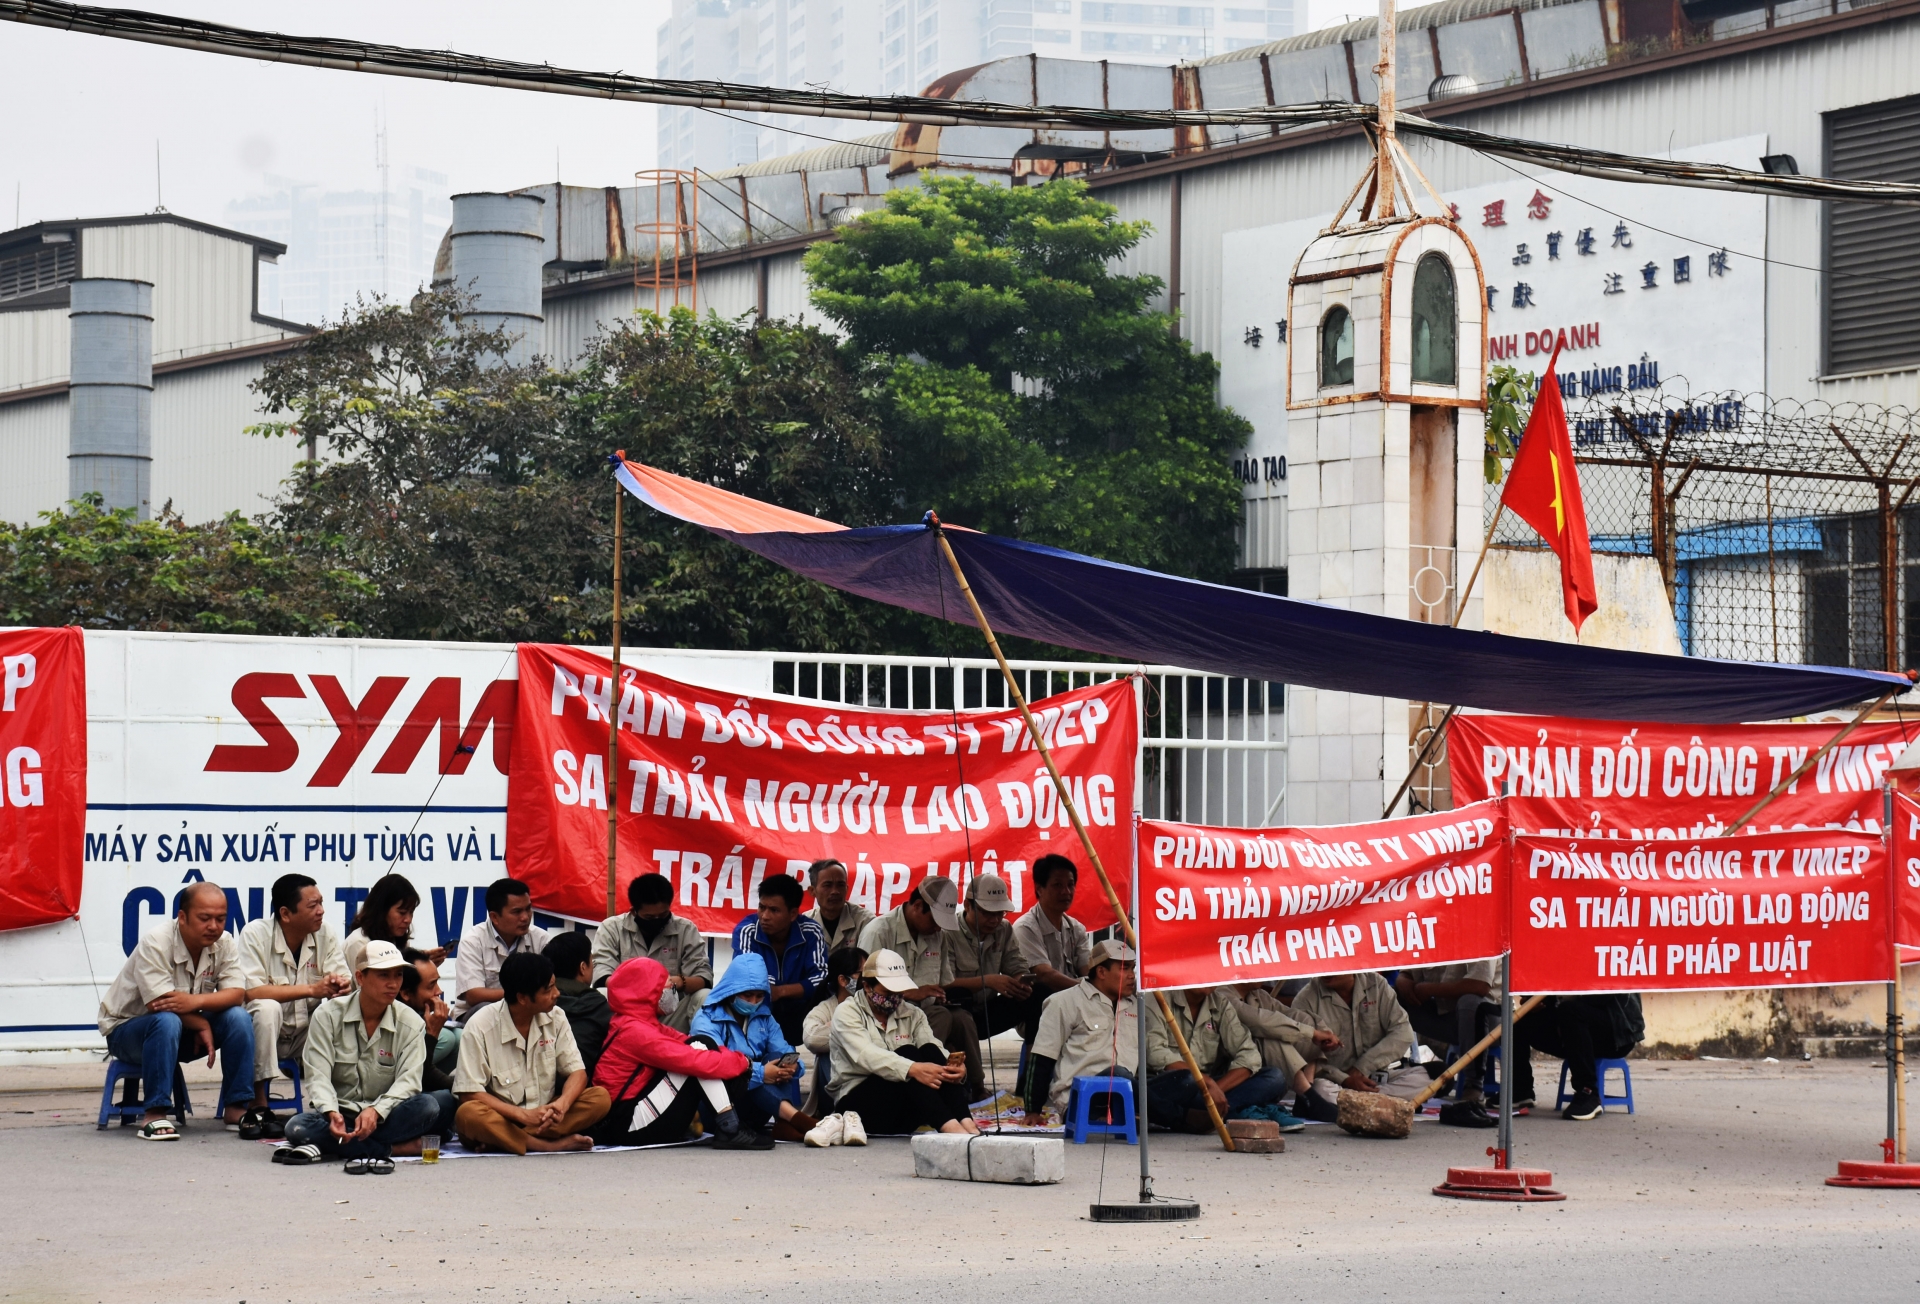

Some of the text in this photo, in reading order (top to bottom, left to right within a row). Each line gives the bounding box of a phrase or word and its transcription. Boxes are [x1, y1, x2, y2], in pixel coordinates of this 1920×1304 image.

[1511, 220, 1633, 266] 品質優先
[1603, 247, 1732, 296] 注重團隊
[1488, 334, 1519, 362] NH
[1581, 362, 1622, 397] HÀNG
[1234, 453, 1287, 487] ĐÀO TẠO
[204, 671, 517, 787] SYM
[552, 662, 686, 739] PHẢN
[786, 714, 925, 755] CÔNG
[922, 723, 981, 754] TY
[989, 698, 1109, 752] VMEP
[0, 747, 43, 807] G
[1483, 729, 1580, 798] PHẢN
[1591, 729, 1650, 797] ĐỐI
[1663, 736, 1757, 797] CÔNG
[1768, 746, 1808, 794] TY
[553, 750, 1115, 840] SA THẢI NGƯỜI LAO ĐỘNG
[86, 825, 147, 861] MÁY
[157, 821, 212, 862] SẢN
[221, 822, 295, 862] XUẤT
[305, 834, 355, 868] PHỤ
[364, 826, 433, 861] TÙNG
[447, 826, 481, 861] VÀ
[1154, 829, 1235, 868] PHẢN
[1294, 838, 1363, 868] CÔNG
[1367, 836, 1402, 863] TY
[1409, 817, 1493, 856] VMEP
[1530, 843, 1870, 880] PHẢN ĐỐI CÔNG TY VMEP
[650, 842, 768, 912] TRÁI
[785, 852, 911, 916] PÁP
[1156, 863, 1491, 920] SA THẢI NGƯỜI LAO ĐỘNG
[1530, 886, 1869, 928] SA THẢI NGƯỜI LAO ĐỘNG
[1218, 912, 1437, 967] TRÁI PHÁP LUẬT
[1595, 935, 1811, 977] TRÁI PHÁP LUẬT
